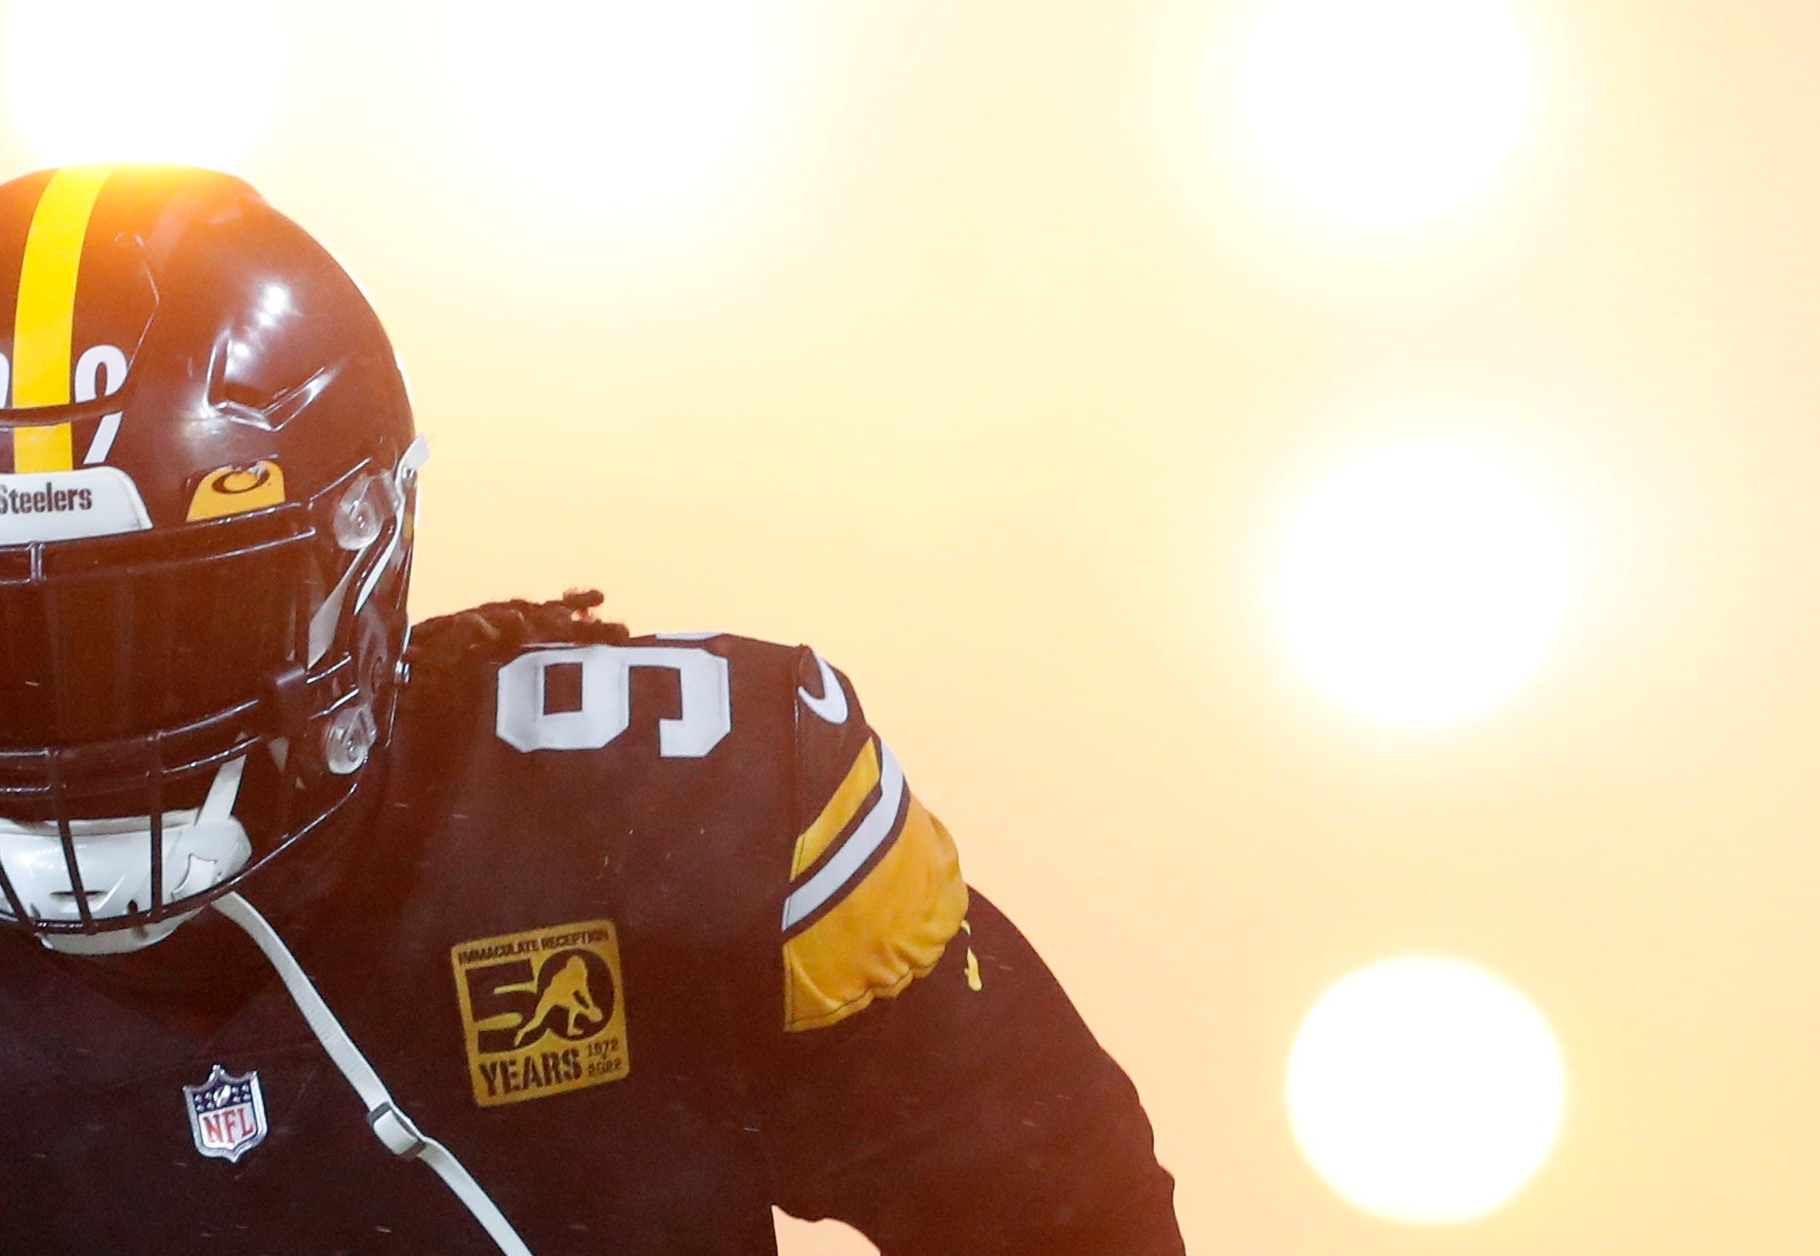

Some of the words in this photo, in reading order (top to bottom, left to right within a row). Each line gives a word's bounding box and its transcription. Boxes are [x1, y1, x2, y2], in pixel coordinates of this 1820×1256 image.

[465, 948, 616, 1055] 50
[479, 1048, 583, 1097] YEARS
[203, 1107, 255, 1144] NFL
